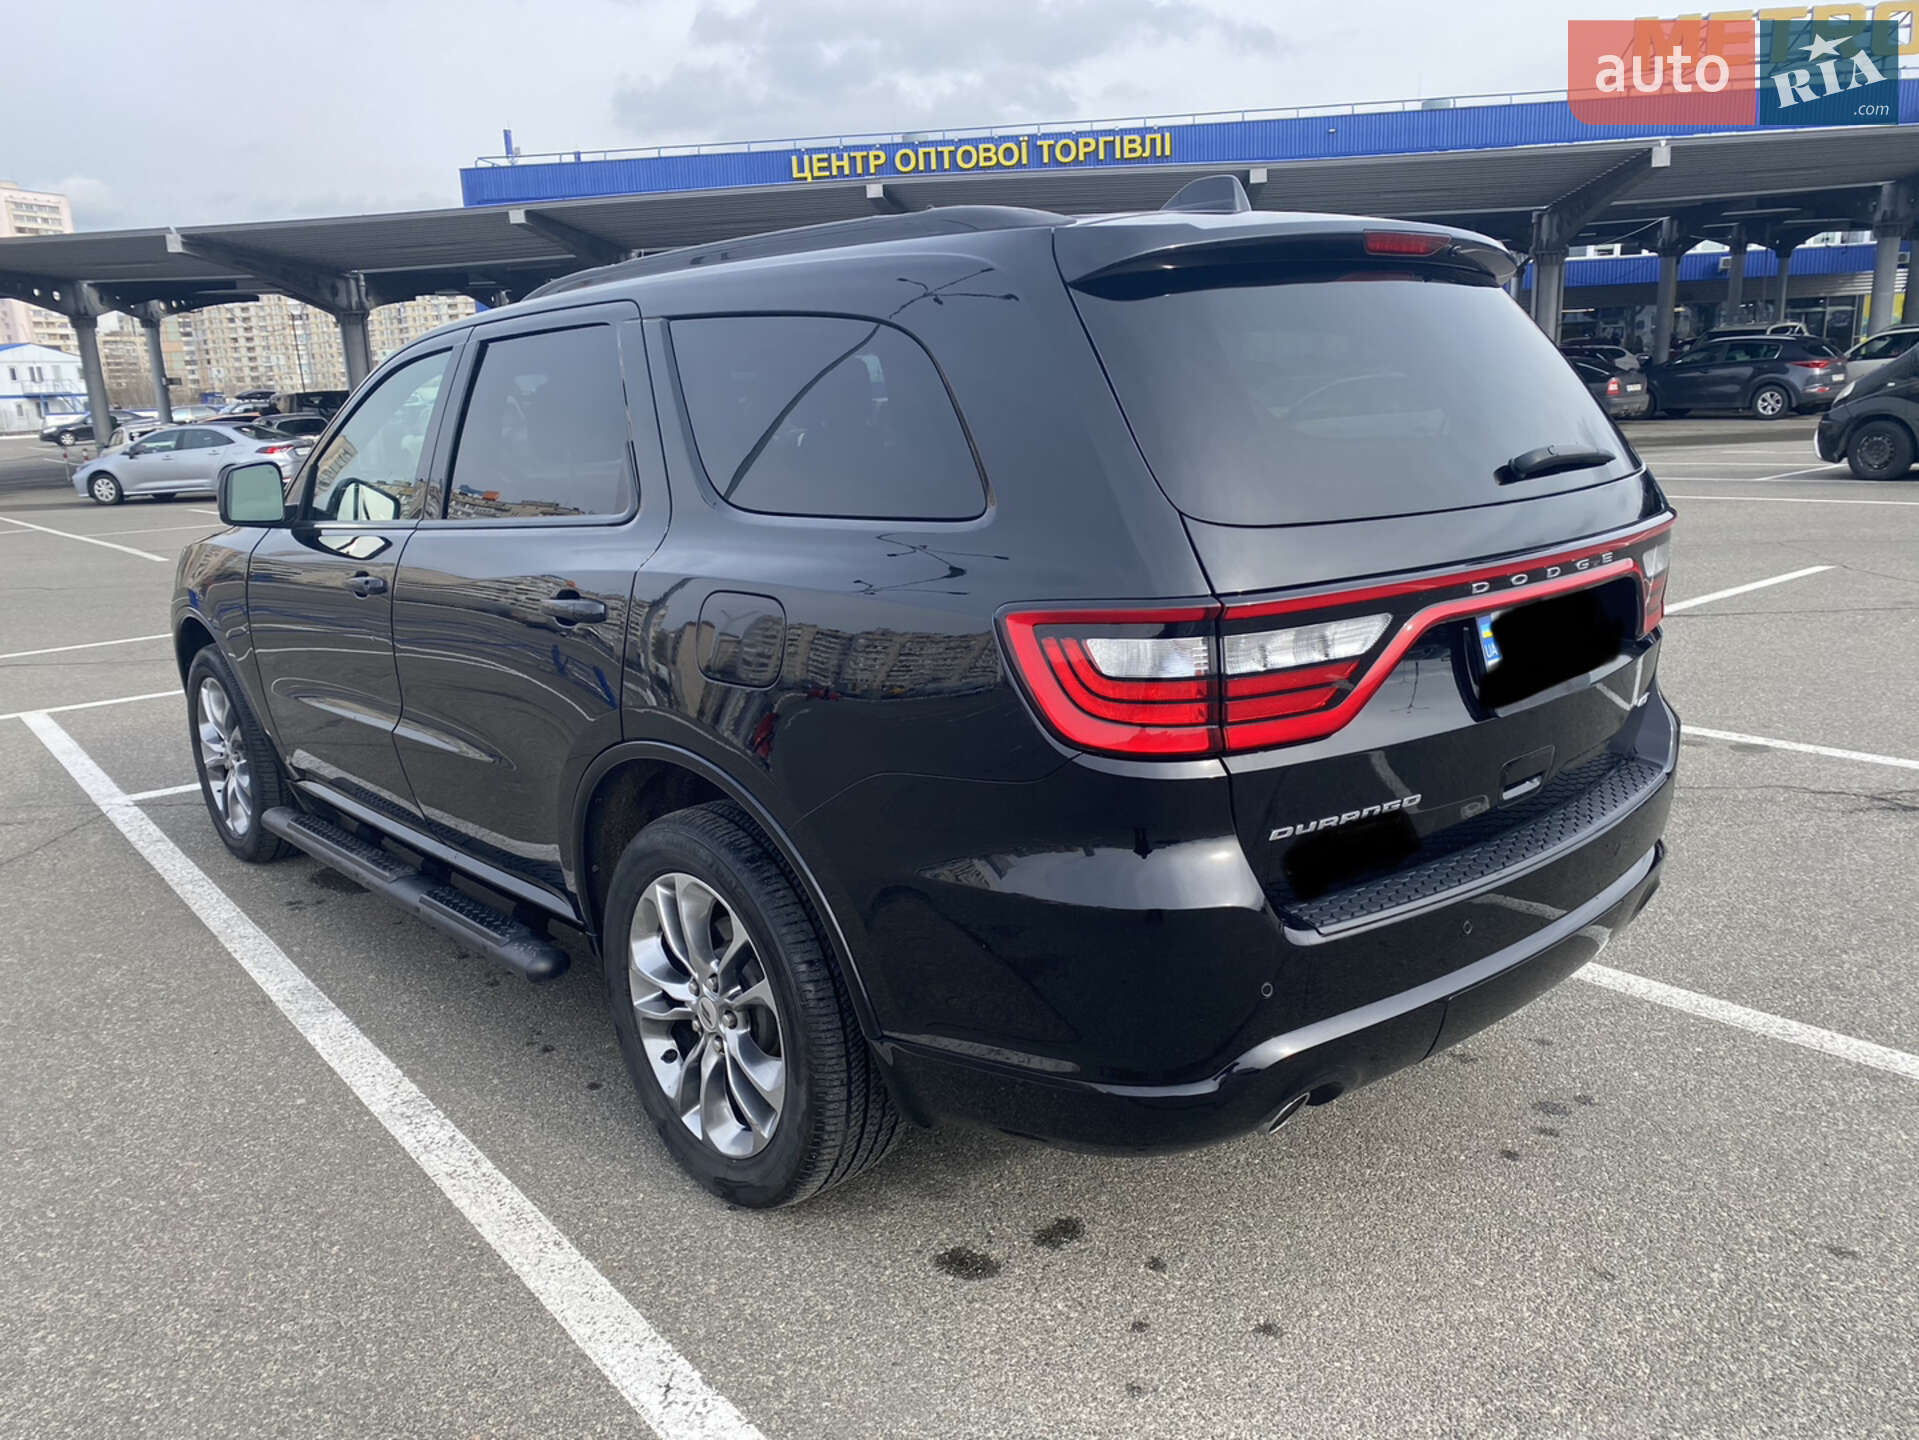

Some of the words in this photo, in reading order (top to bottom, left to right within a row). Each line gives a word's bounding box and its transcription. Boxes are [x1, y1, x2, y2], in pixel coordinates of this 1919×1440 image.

[791, 149, 886, 182] ЦЕНТР
[895, 136, 1028, 173] ОПТОВОЇ
[1037, 132, 1171, 164] ТОРГІВЛІ
[1471, 551, 1614, 595] DODGE
[1268, 793, 1423, 841] DURANGO
